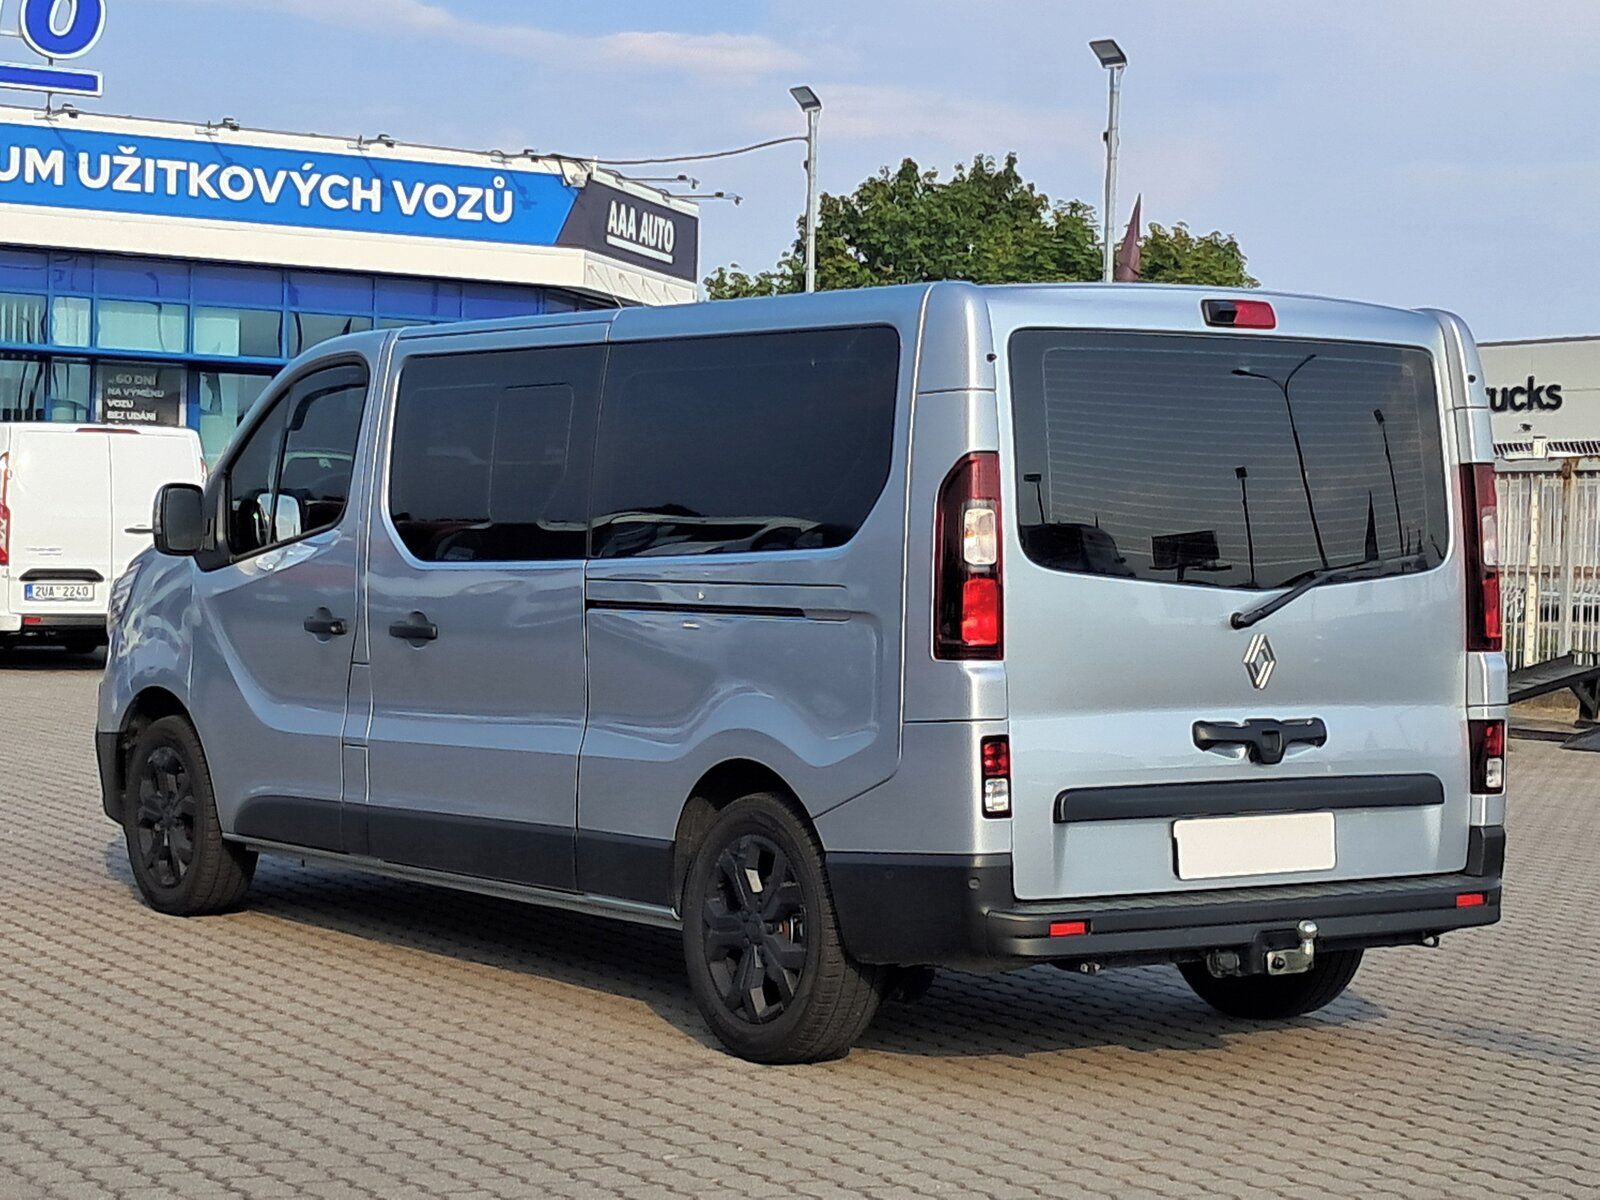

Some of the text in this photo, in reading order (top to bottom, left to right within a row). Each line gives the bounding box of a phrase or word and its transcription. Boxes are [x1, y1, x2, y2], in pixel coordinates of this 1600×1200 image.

[0, 145, 514, 223] UM UŽITKOVÝCH VOZŮ
[607, 200, 674, 253] AAA AUTO
[35, 586, 89, 597] 2UA 2240
